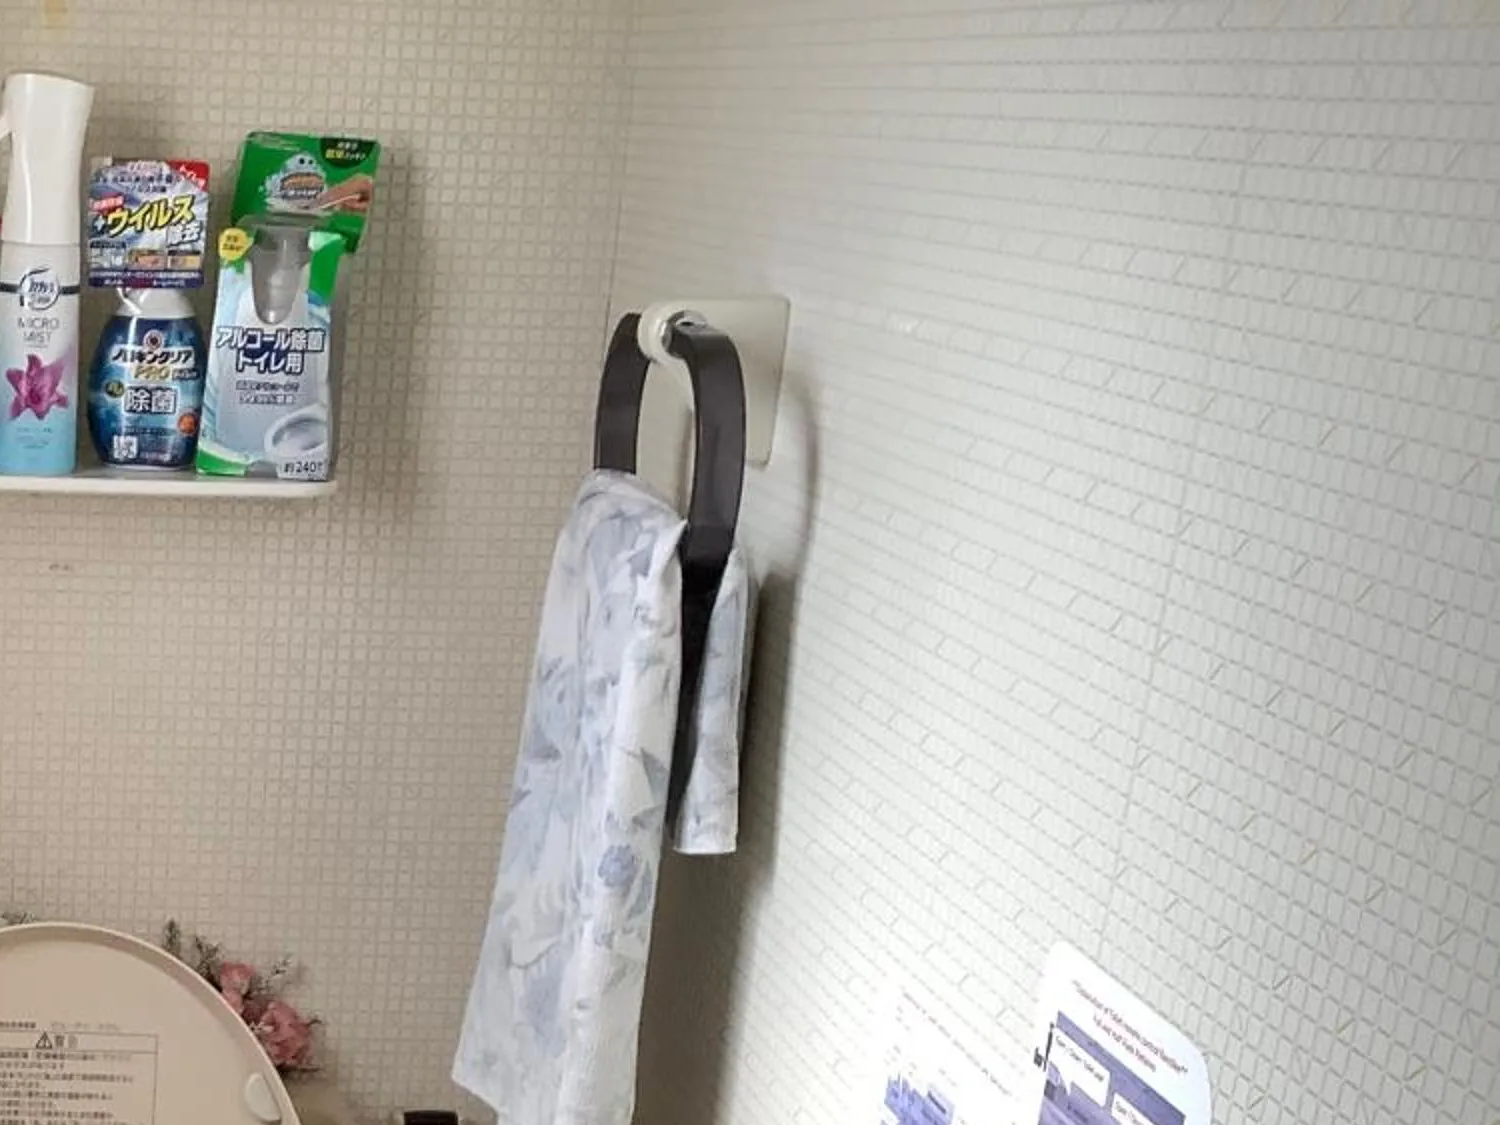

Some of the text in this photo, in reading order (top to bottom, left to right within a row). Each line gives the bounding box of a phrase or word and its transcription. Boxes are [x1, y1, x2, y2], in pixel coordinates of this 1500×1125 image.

[106, 195, 196, 238] ウイルス
[18, 317, 60, 329] MICRO
[217, 328, 325, 351] アルコール除菌
[237, 352, 304, 374] トイレ用
[127, 387, 176, 414] 除菌
